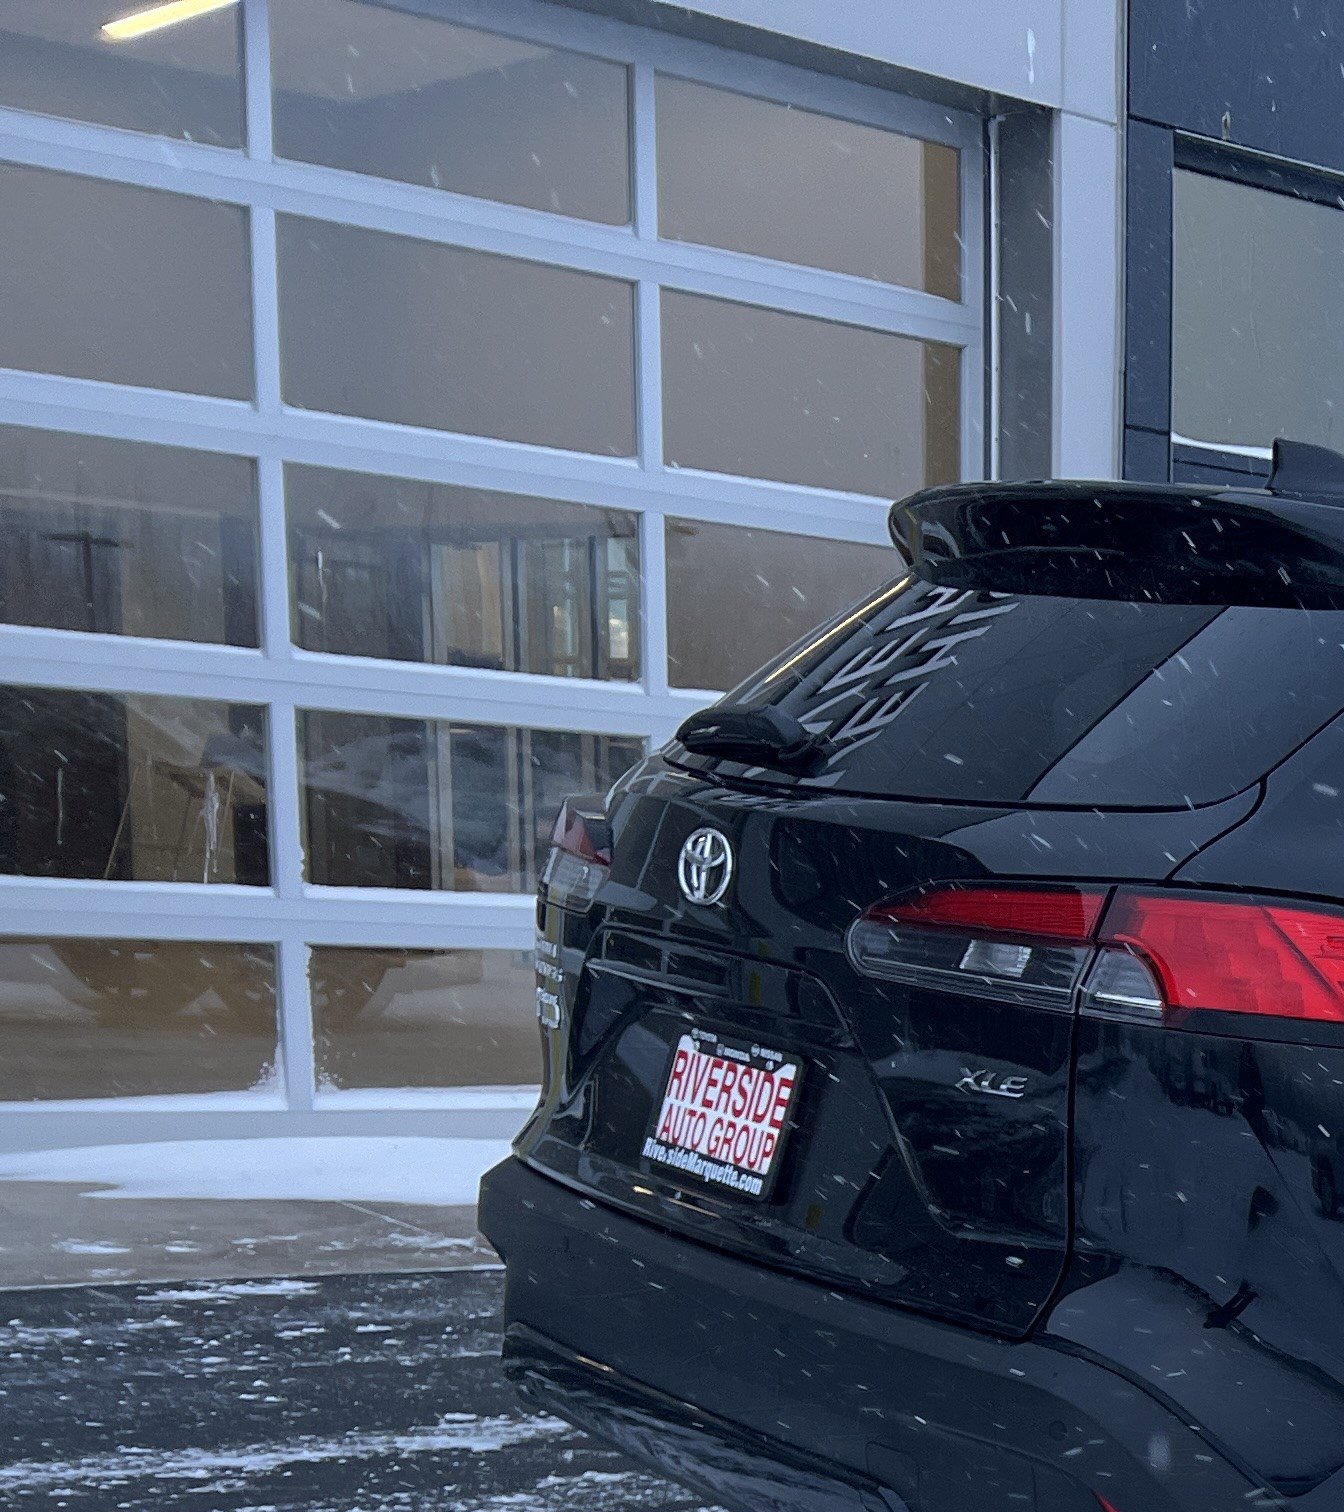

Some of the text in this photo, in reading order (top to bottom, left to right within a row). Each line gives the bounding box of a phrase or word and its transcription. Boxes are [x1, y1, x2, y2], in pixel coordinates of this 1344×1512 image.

[667, 1049, 794, 1130] RIVERSIDE
[955, 1067, 1028, 1098] XLE
[659, 1103, 776, 1170] AUTO GROUP
